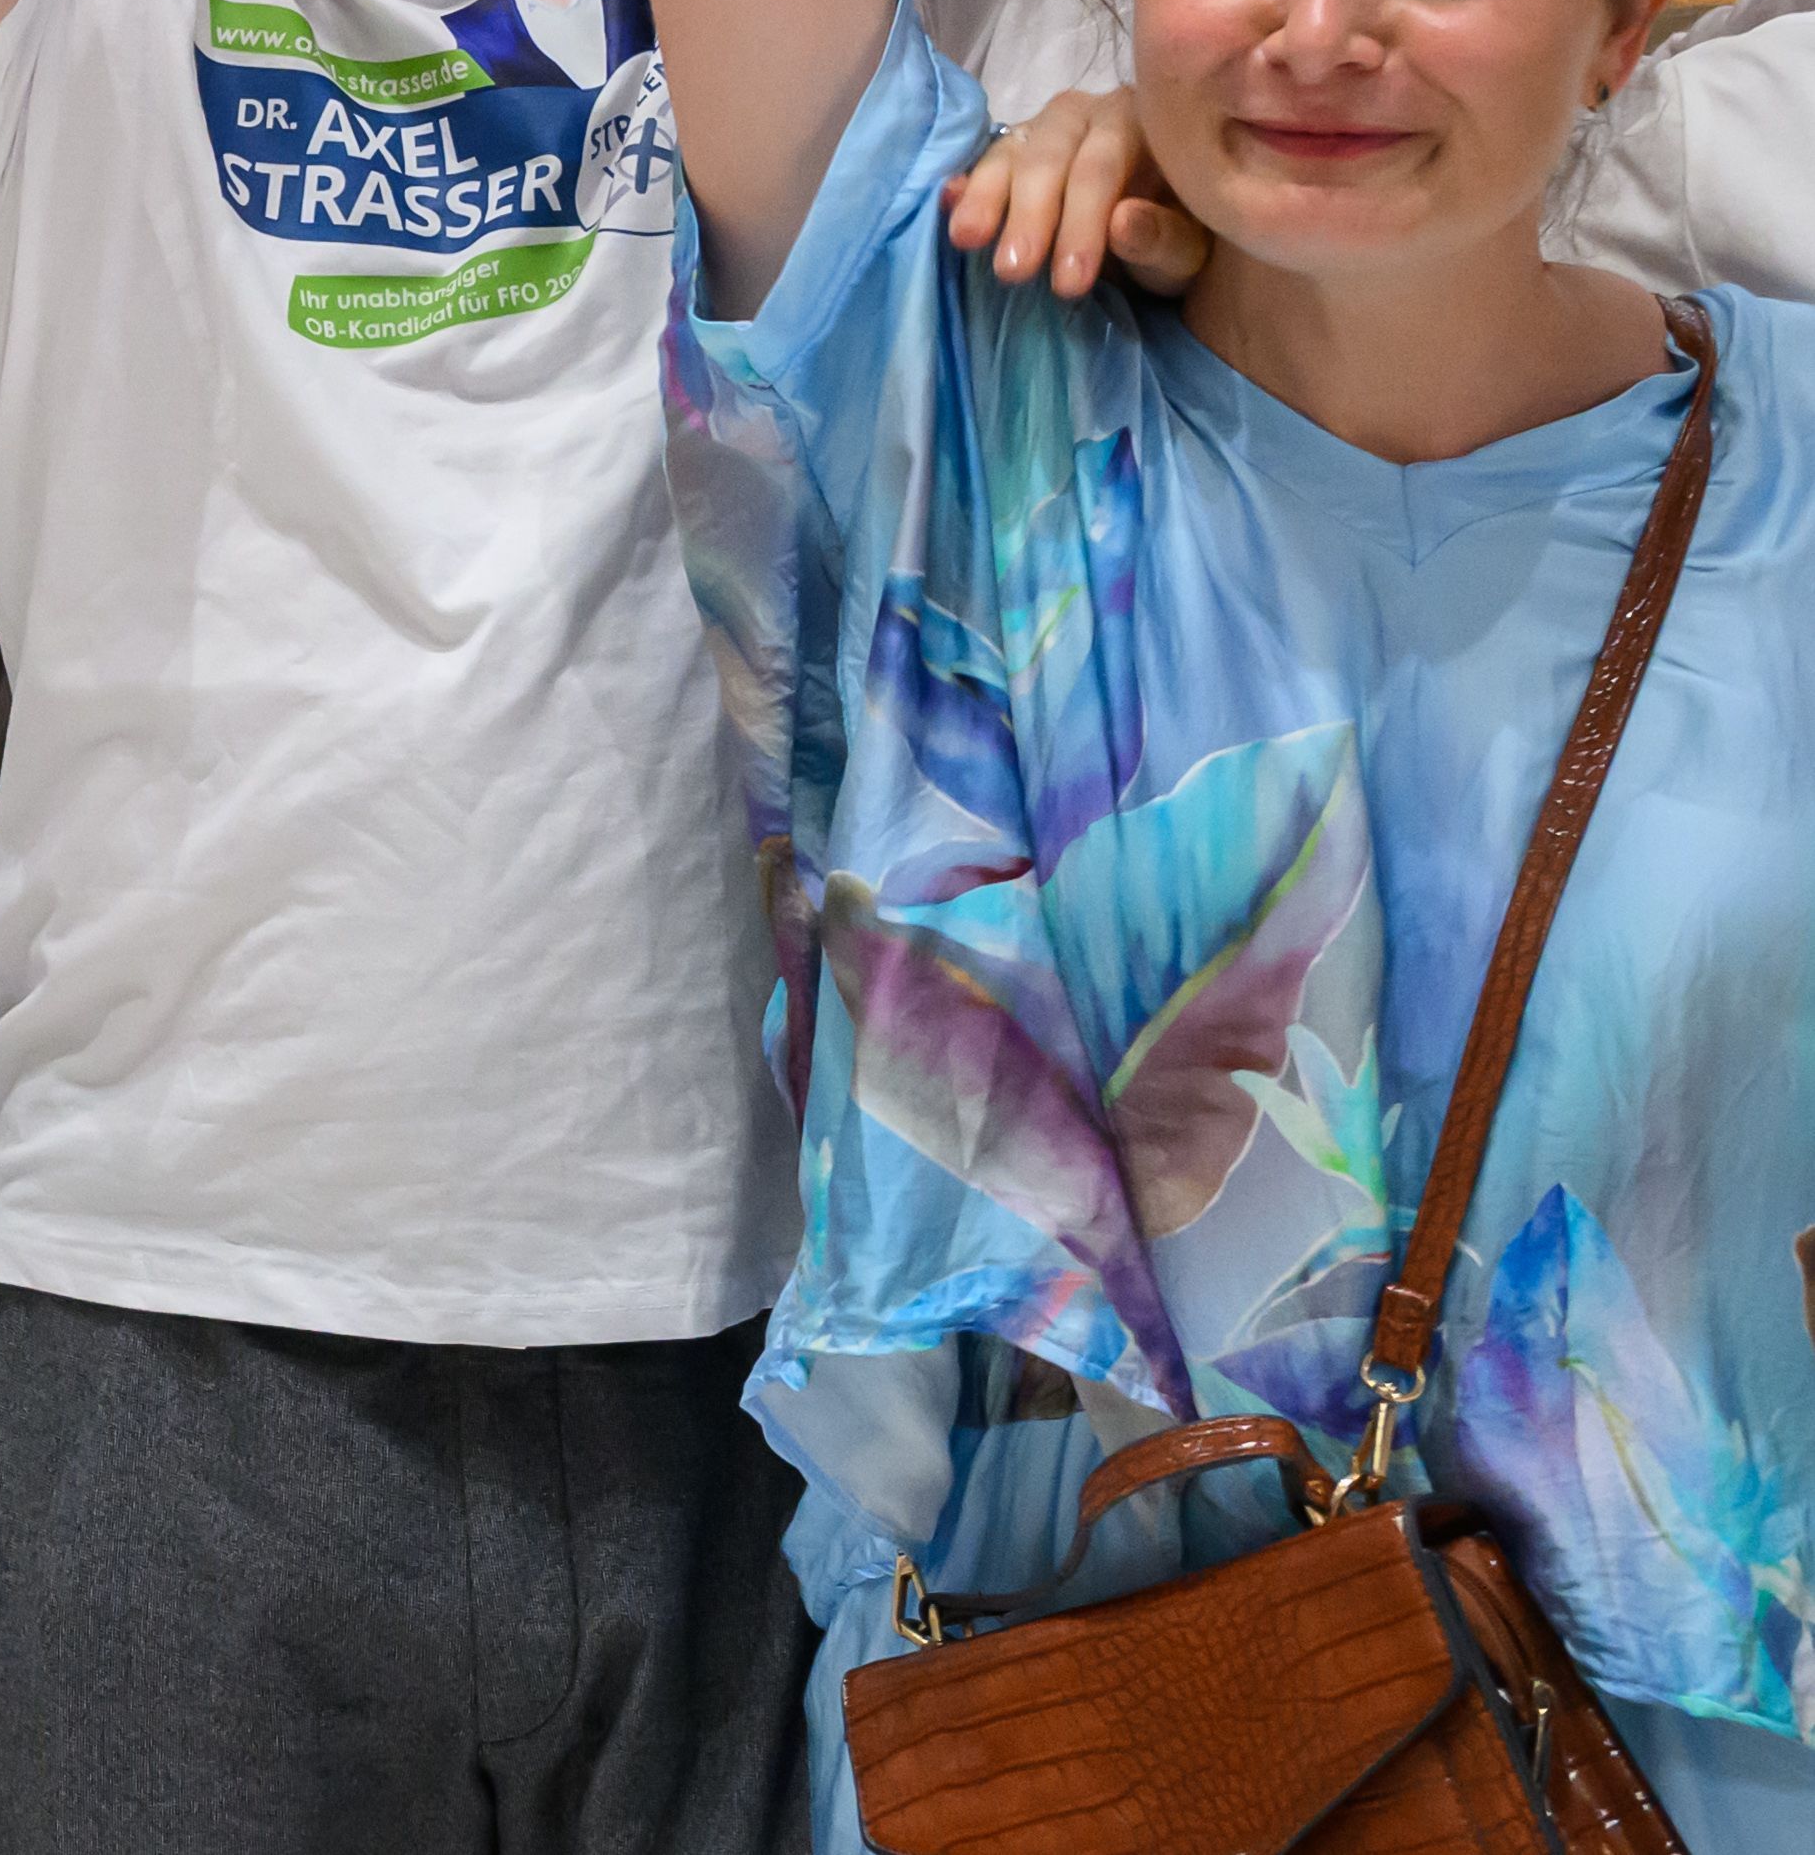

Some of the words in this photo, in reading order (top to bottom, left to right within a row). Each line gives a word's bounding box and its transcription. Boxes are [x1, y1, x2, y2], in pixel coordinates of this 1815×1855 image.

[237, 98, 297, 130] DR.
[307, 99, 478, 178] AXEL
[223, 153, 563, 239] STRASSER
[300, 289, 328, 309] Ihr
[338, 259, 500, 310] unabhängiger
[306, 303, 455, 339] OB-Kandidat
[458, 292, 489, 315] für
[498, 282, 539, 308] FFO
[546, 264, 583, 298] 202
